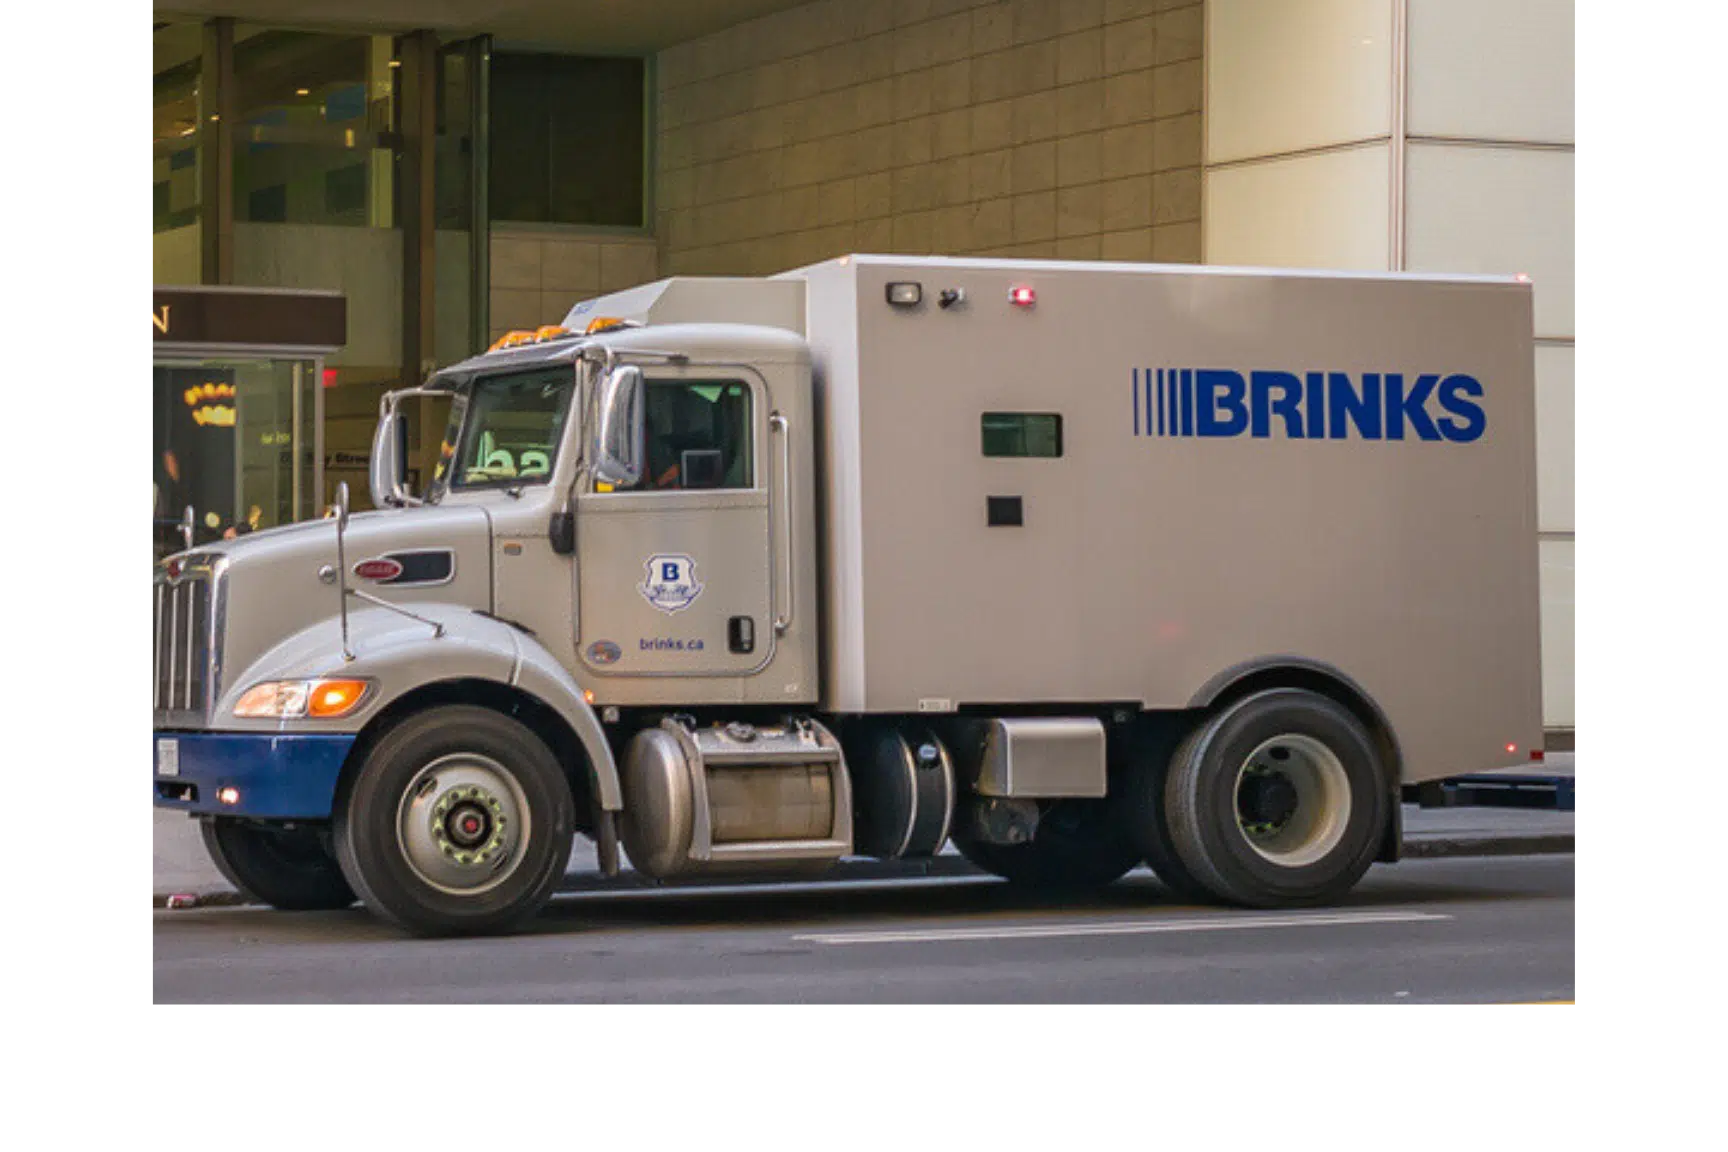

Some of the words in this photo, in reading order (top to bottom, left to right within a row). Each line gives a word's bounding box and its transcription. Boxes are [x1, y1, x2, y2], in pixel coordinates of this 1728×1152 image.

[1196, 368, 1487, 443] BRINKS
[662, 562, 680, 581] B
[639, 638, 704, 651] brinks.ca
